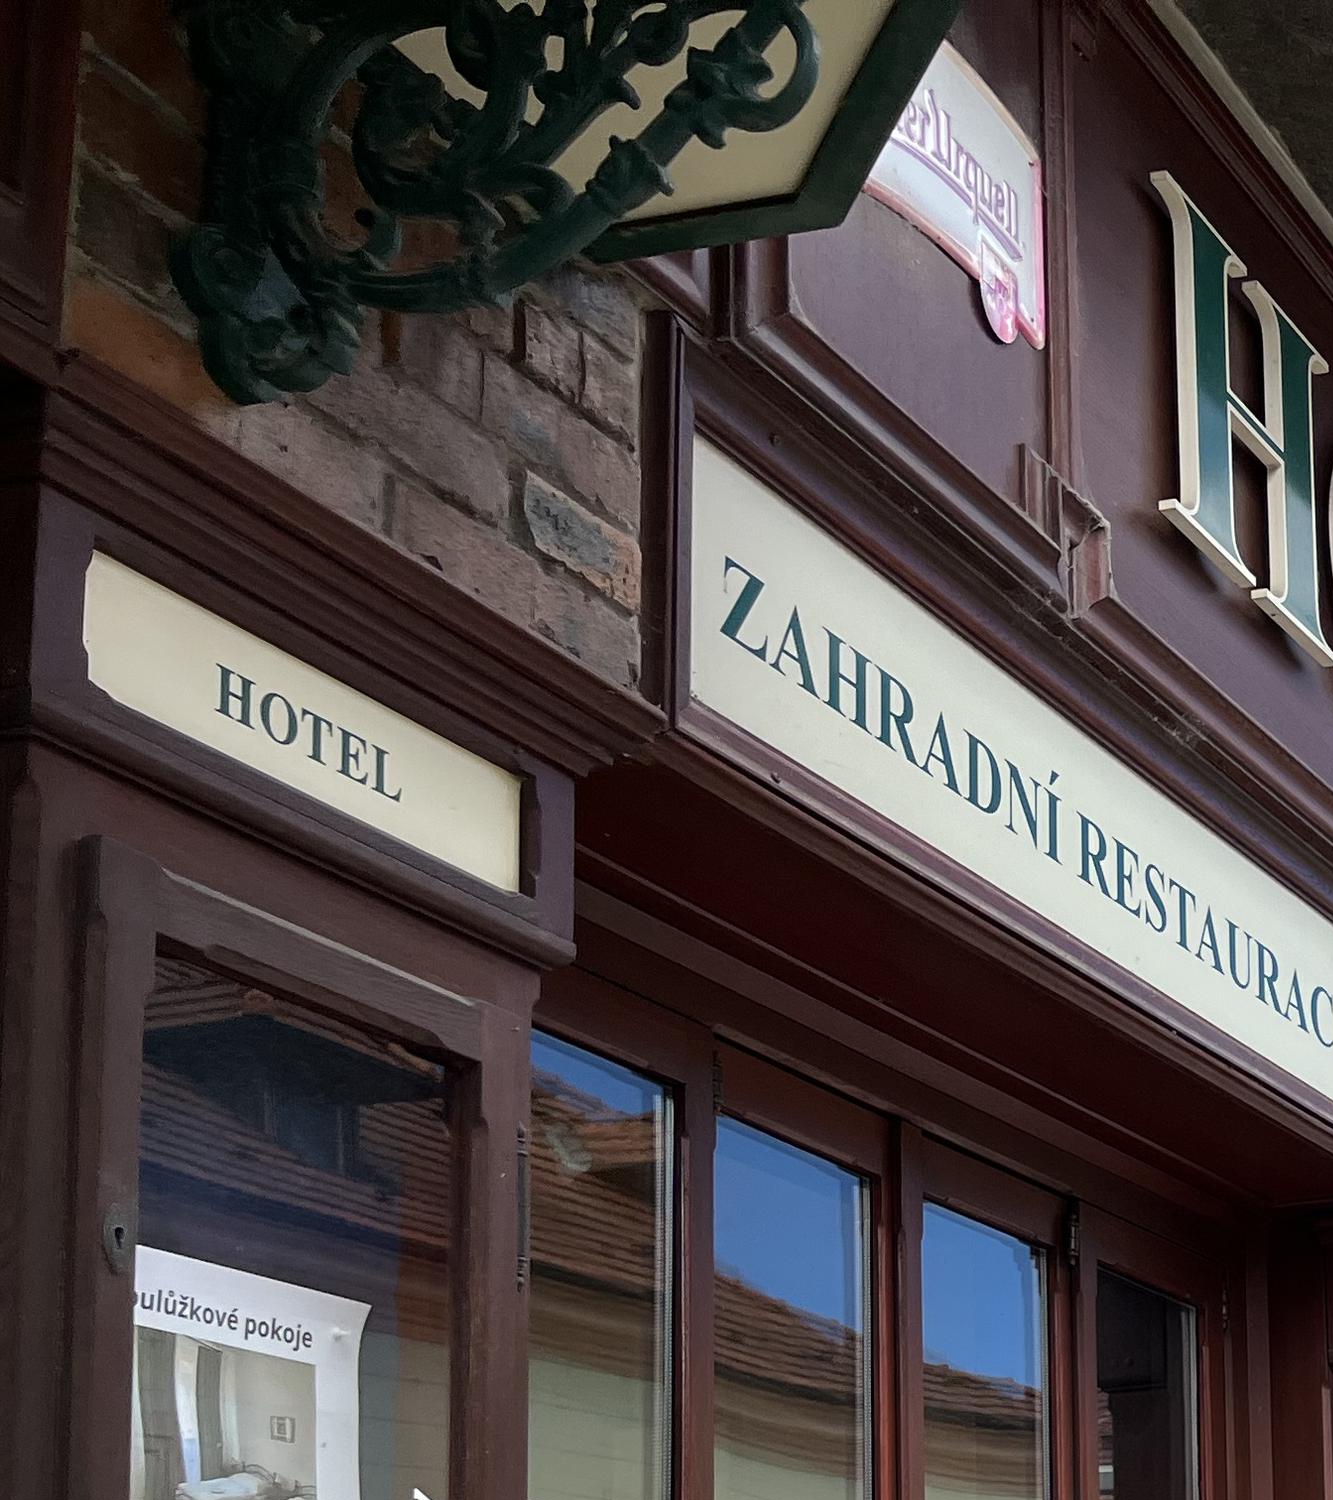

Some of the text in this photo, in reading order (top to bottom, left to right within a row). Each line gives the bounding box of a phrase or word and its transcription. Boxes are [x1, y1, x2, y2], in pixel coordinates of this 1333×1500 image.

[923, 87, 1020, 247] Urquell
[214, 661, 402, 802] HOTEL
[719, 555, 1062, 865] ZAHRADNÍ
[244, 1317, 313, 1352] pokoje
